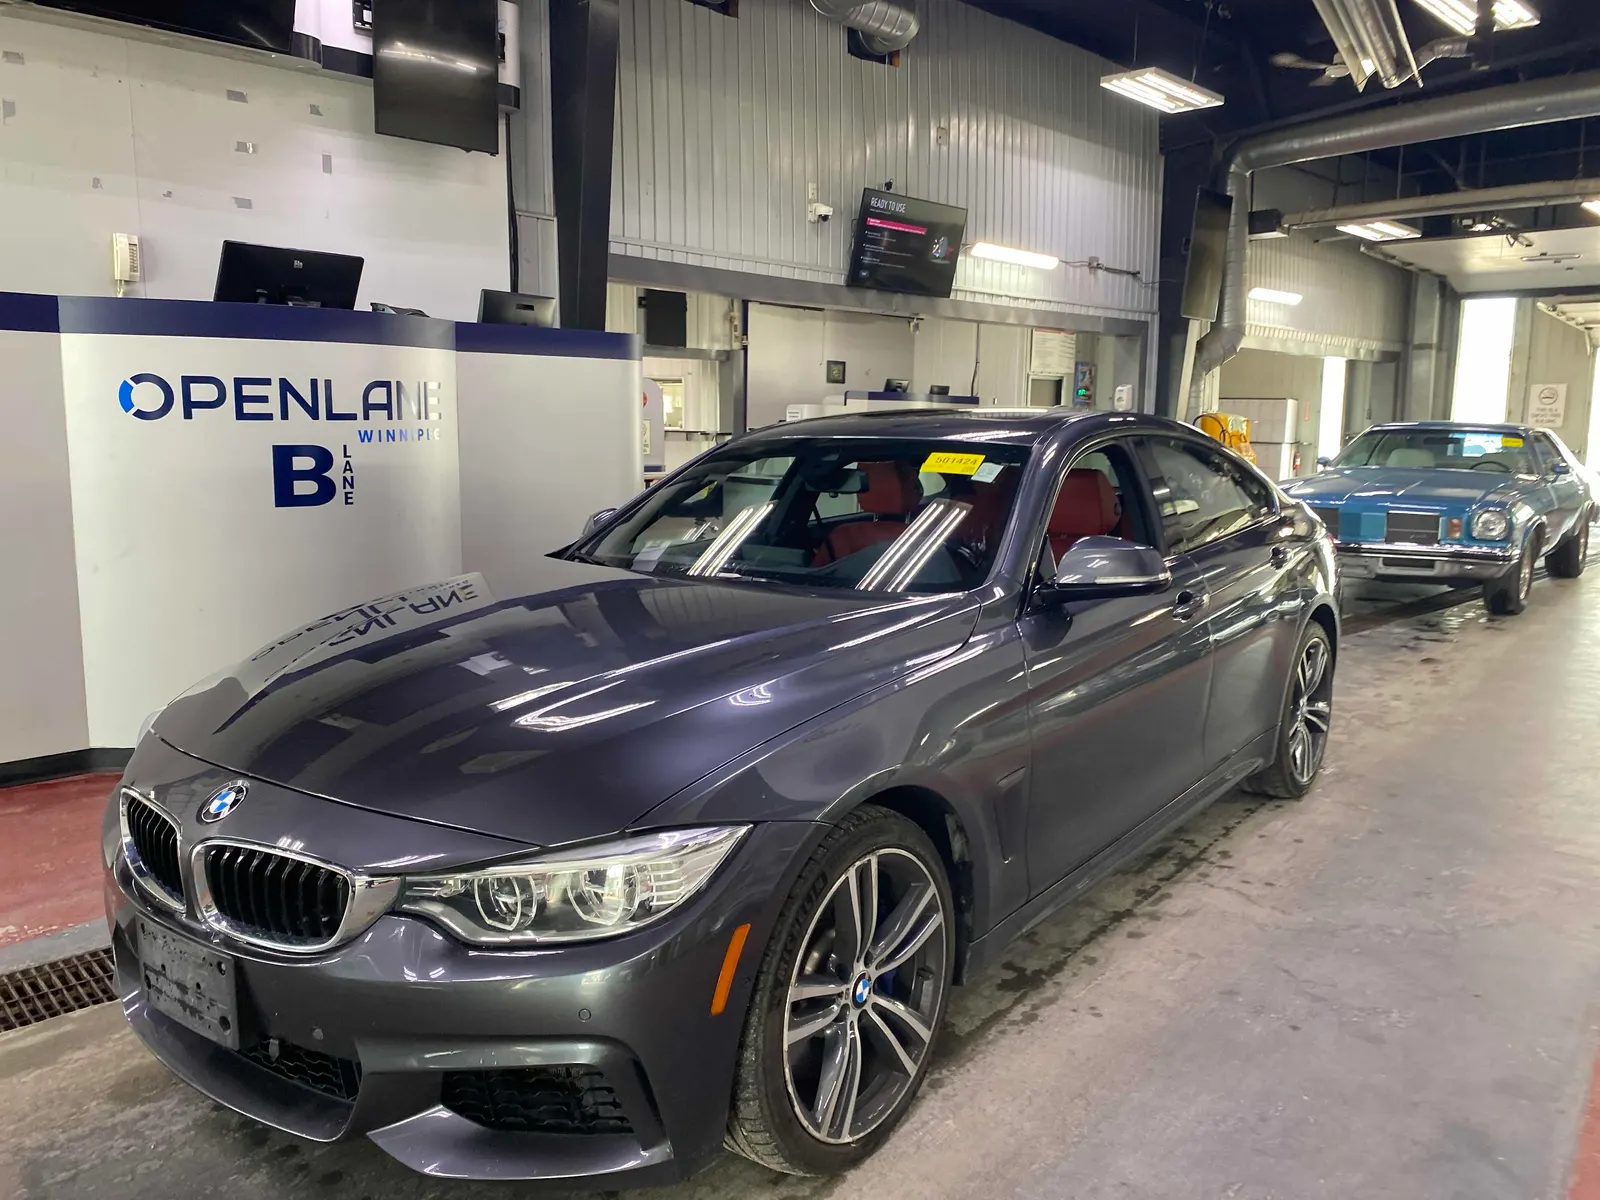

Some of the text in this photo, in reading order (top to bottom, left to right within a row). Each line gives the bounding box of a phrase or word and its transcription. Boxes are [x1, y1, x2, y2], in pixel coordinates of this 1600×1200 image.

[870, 197, 888, 209] READY
[889, 200, 895, 211] TO
[896, 203, 906, 213] USE
[118, 373, 442, 421] OPENLANE
[272, 444, 354, 508] B LANE
